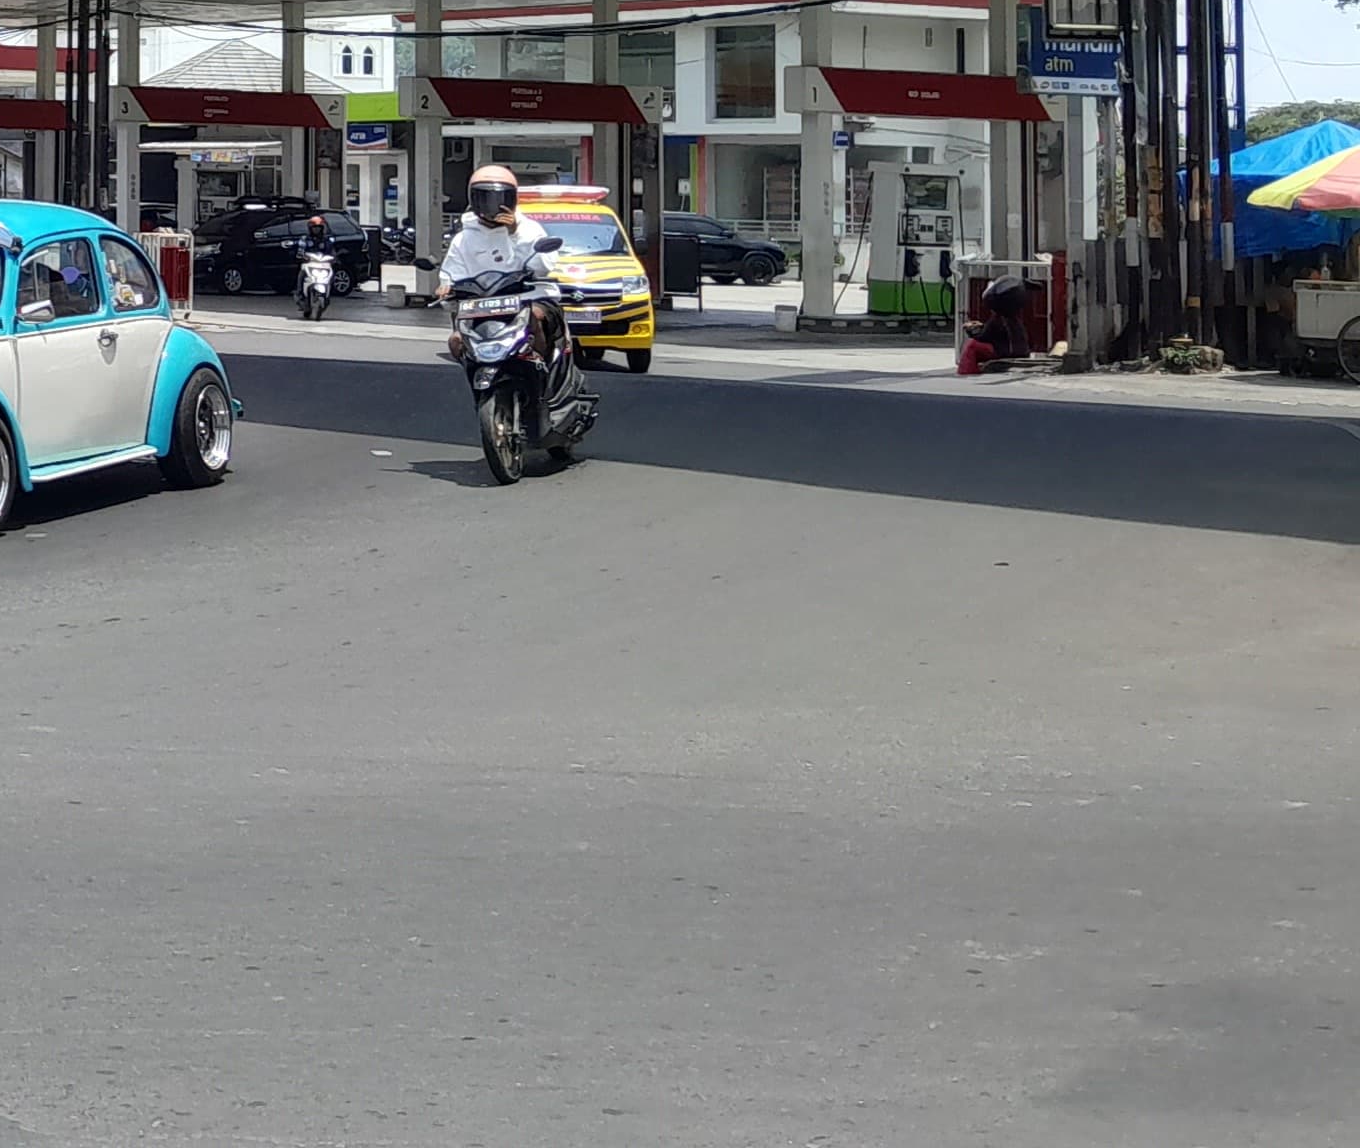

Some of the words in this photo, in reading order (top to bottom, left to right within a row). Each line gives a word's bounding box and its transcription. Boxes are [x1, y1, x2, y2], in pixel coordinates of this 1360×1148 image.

[1044, 55, 1074, 73] atm
[121, 101, 130, 115] 3
[420, 94, 430, 110] 2
